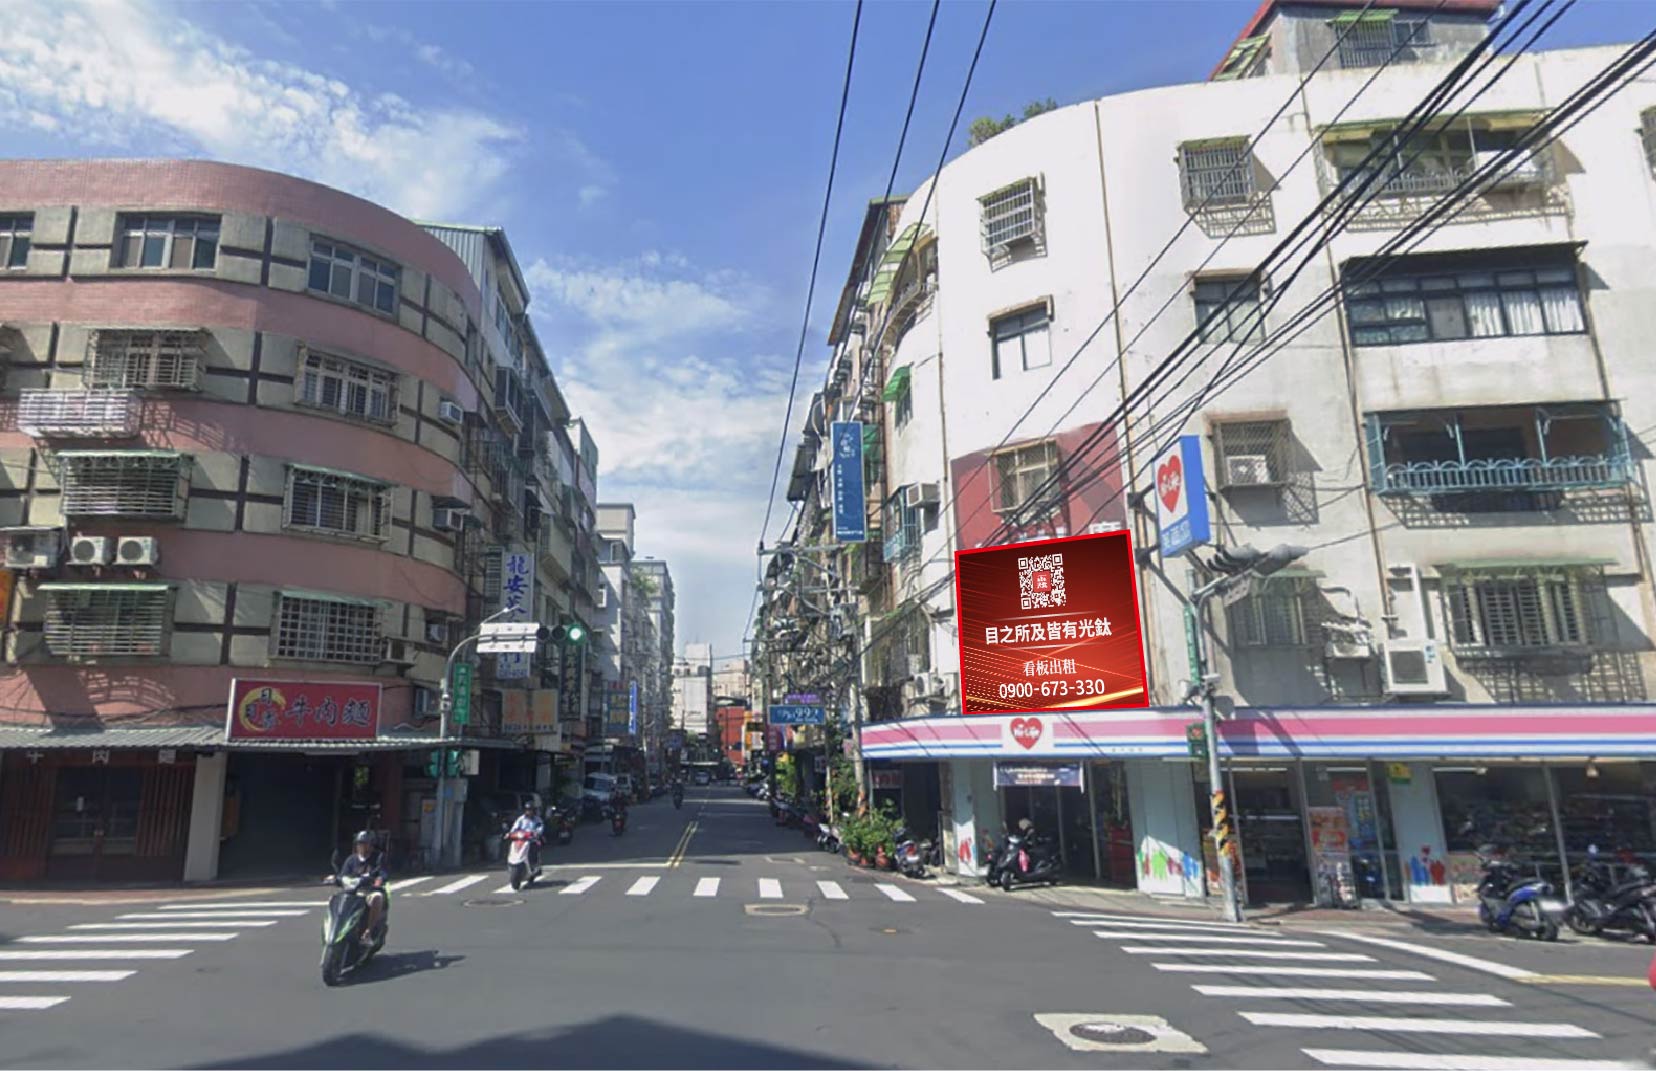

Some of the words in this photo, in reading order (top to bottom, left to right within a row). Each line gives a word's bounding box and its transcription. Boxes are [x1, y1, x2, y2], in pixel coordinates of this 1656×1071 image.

[985, 617, 1112, 645] 目之所及皆有光鈦
[1023, 659, 1077, 677] 看板出租
[999, 679, 1105, 698] 0900-673-330
[285, 694, 372, 728] 牛肉麵
